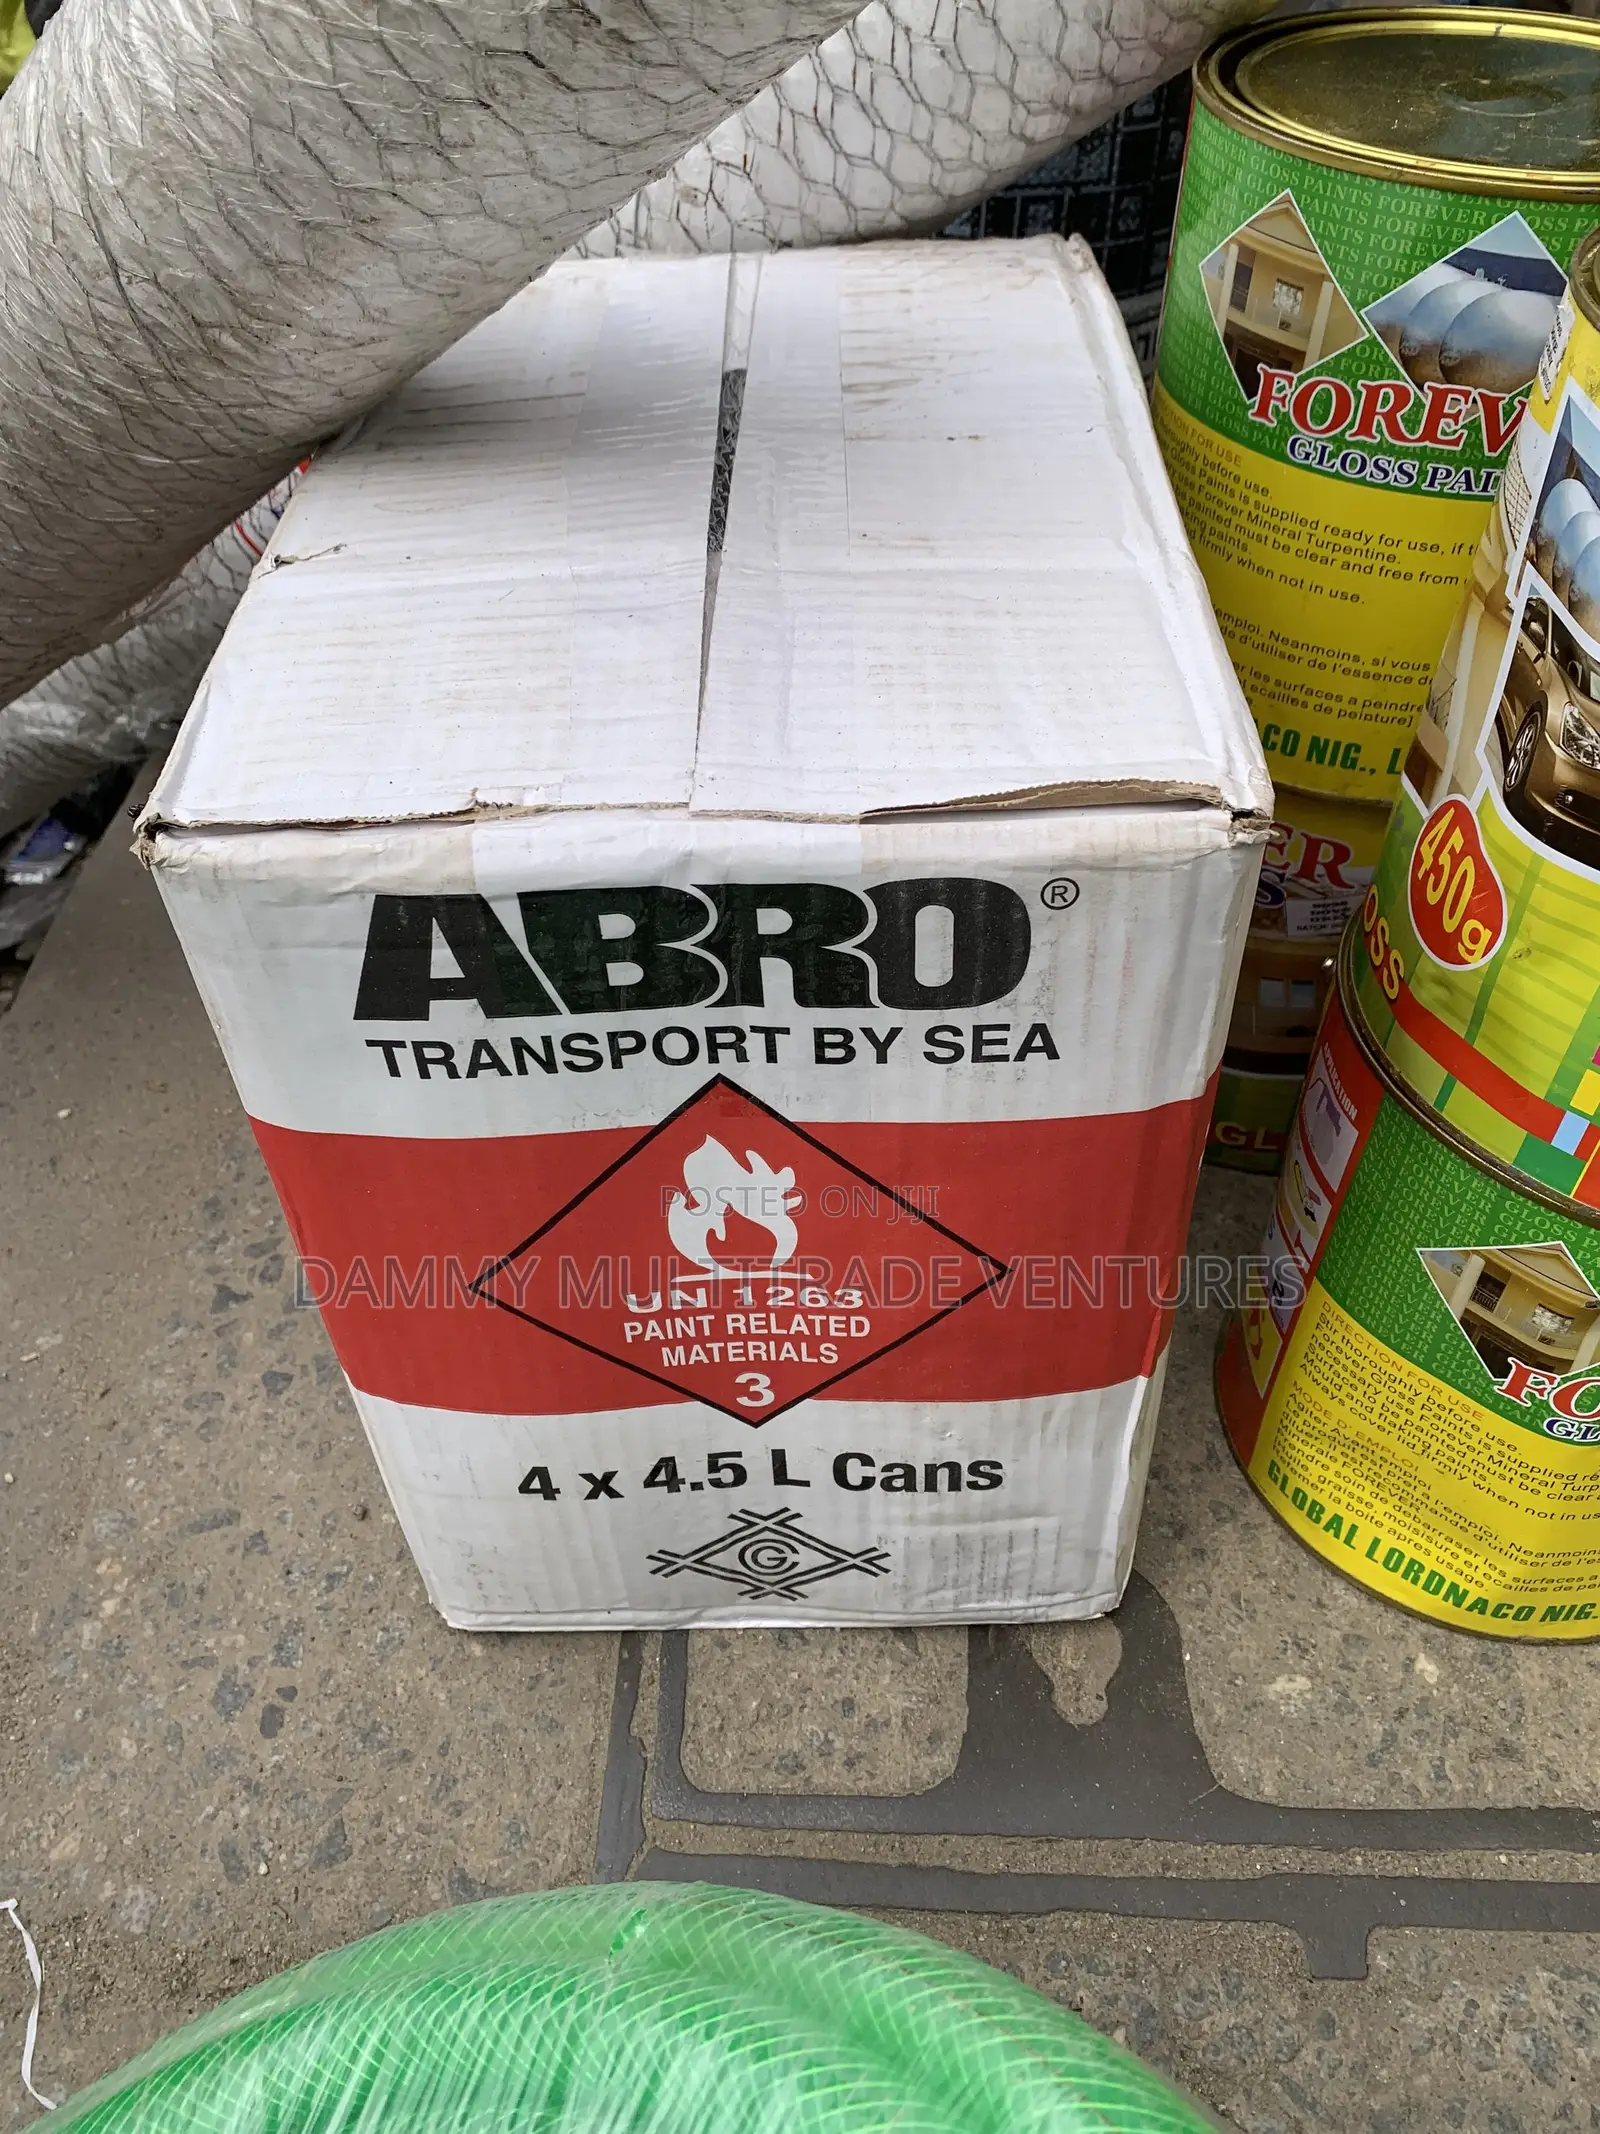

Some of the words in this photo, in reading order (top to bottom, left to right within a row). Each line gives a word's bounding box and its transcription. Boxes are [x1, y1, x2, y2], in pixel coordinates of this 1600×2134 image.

[1303, 175, 1373, 207] PAINTS
[1376, 195, 1488, 226] FOREVER
[1202, 454, 1241, 486] before
[1244, 479, 1273, 499] use.
[1215, 444, 1242, 467] USE
[1287, 435, 1417, 485] GLOSS
[1188, 495, 1232, 529] painted
[1234, 523, 1272, 547] must
[1272, 535, 1291, 554] be
[1295, 547, 1338, 567] clear
[1340, 560, 1374, 575] and
[1379, 565, 1413, 582] free
[1418, 571, 1460, 586] from
[1198, 467, 1236, 499] Paints
[1239, 488, 1250, 505] is
[1253, 498, 1320, 531] supplied
[1323, 523, 1374, 546] ready
[1378, 533, 1403, 550] for
[1407, 540, 1445, 556] use,
[1451, 542, 1465, 556] if
[1198, 483, 1244, 518] Forever
[1247, 510, 1302, 543] Mineral
[1306, 532, 1400, 565] Turpentine.
[1209, 526, 1252, 555] paints.
[1236, 557, 1274, 580] when
[1278, 572, 1305, 592] not
[1309, 580, 1324, 595] in
[1329, 589, 1365, 605] use.
[1239, 634, 1304, 665] d'utiliser
[1307, 658, 1327, 671] de
[1331, 662, 1413, 686] l'essence
[1249, 666, 1270, 684] les
[1274, 675, 1344, 705] surfaces
[1268, 629, 1366, 666] Neanmoins,
[1371, 656, 1385, 668] si
[1390, 660, 1431, 673] vous
[1313, 702, 1333, 715] de
[1418, 805, 1494, 964] 450g
[353, 877, 1031, 1022] ABRO
[365, 1025, 791, 1080] TRANSPORT
[813, 1027, 904, 1065] BY
[923, 1022, 1061, 1065] SEA
[623, 1314, 715, 1343] PAINT
[726, 1313, 871, 1338] RELATED
[626, 1287, 708, 1314] UN
[732, 1286, 864, 1309] 1263
[661, 1341, 839, 1367] MATERIALS
[734, 1373, 775, 1408] 3
[1319, 1312, 1339, 1335] Stir
[1341, 1335, 1422, 1398] thoroughly
[1426, 1395, 1481, 1432] before
[1485, 1432, 1522, 1456] use.
[1322, 1300, 1403, 1372] DIRECTION
[1406, 1370, 1443, 1397] FOR
[1447, 1395, 1485, 1422] USE
[1280, 1418, 1338, 1463] Minerale
[1289, 1393, 1329, 1428] Agiter
[1330, 1427, 1376, 1456] Avant
[1379, 1455, 1432, 1491] emploi
[1291, 1380, 1333, 1421] MODE
[1355, 1431, 1420, 1472] EMPLOI
[1300, 1363, 1345, 1407] Always
[1349, 1406, 1394, 1439] cover
[1397, 1435, 1416, 1451] lid
[1420, 1449, 1468, 1481] firmly
[1472, 1480, 1519, 1509] when
[1525, 1506, 1556, 1520] not
[1560, 1512, 1576, 1521] in
[1303, 1352, 1343, 1392] Mould
[1345, 1392, 1375, 1415] and
[1378, 1411, 1432, 1450] flaking
[1436, 1449, 1491, 1486] paints.
[1308, 1342, 1359, 1391] Surface
[1363, 1390, 1377, 1404] to
[1381, 1402, 1401, 1420] be
[1404, 1418, 1467, 1459] painted
[1471, 1458, 1515, 1484] must
[1518, 1481, 1541, 1496] be
[1546, 1492, 1594, 1502] clear
[1311, 1334, 1382, 1396] necessary
[1385, 1395, 1415, 1417] use
[1419, 1414, 1484, 1456] Forever
[1487, 1454, 1556, 1489] Mineral
[1315, 1323, 1367, 1373] Forever
[1370, 1372, 1416, 1406] Gloss
[1420, 1403, 1473, 1440] Paints
[1478, 1437, 1492, 1451] is
[1497, 1450, 1578, 1482] supplied
[518, 1465, 561, 1501] 4
[578, 1470, 625, 1500] x
[642, 1450, 748, 1494] 4.5
[770, 1448, 811, 1488] L
[831, 1452, 1005, 1493] Cans
[1302, 1419, 1356, 1454] produit
[1360, 1452, 1384, 1470] est
[1387, 1469, 1418, 1491] pret
[1266, 1458, 1361, 1551] GLOBAL
[1365, 1536, 1538, 1623] LORDNACO
[1328, 1490, 1341, 1504] la
[1345, 1502, 1384, 1529] boite
[1387, 1526, 1432, 1557] apres
[1435, 1555, 1489, 1592] usage.
[1334, 1470, 1365, 1492] soin
[1369, 1491, 1388, 1505] de
[1392, 1503, 1480, 1559] debarraser
[1483, 1557, 1507, 1578] les
[1512, 1576, 1585, 1585] surfaces
[1340, 1451, 1364, 1467] est
[1367, 1466, 1469, 1533] recommande
[1551, 1559, 1572, 1567] de
[1383, 1511, 1460, 1560] moisisure
[1464, 1559, 1479, 1573] et
[1482, 1572, 1548, 1592] ecailles
[1552, 1583, 1573, 1592] de
